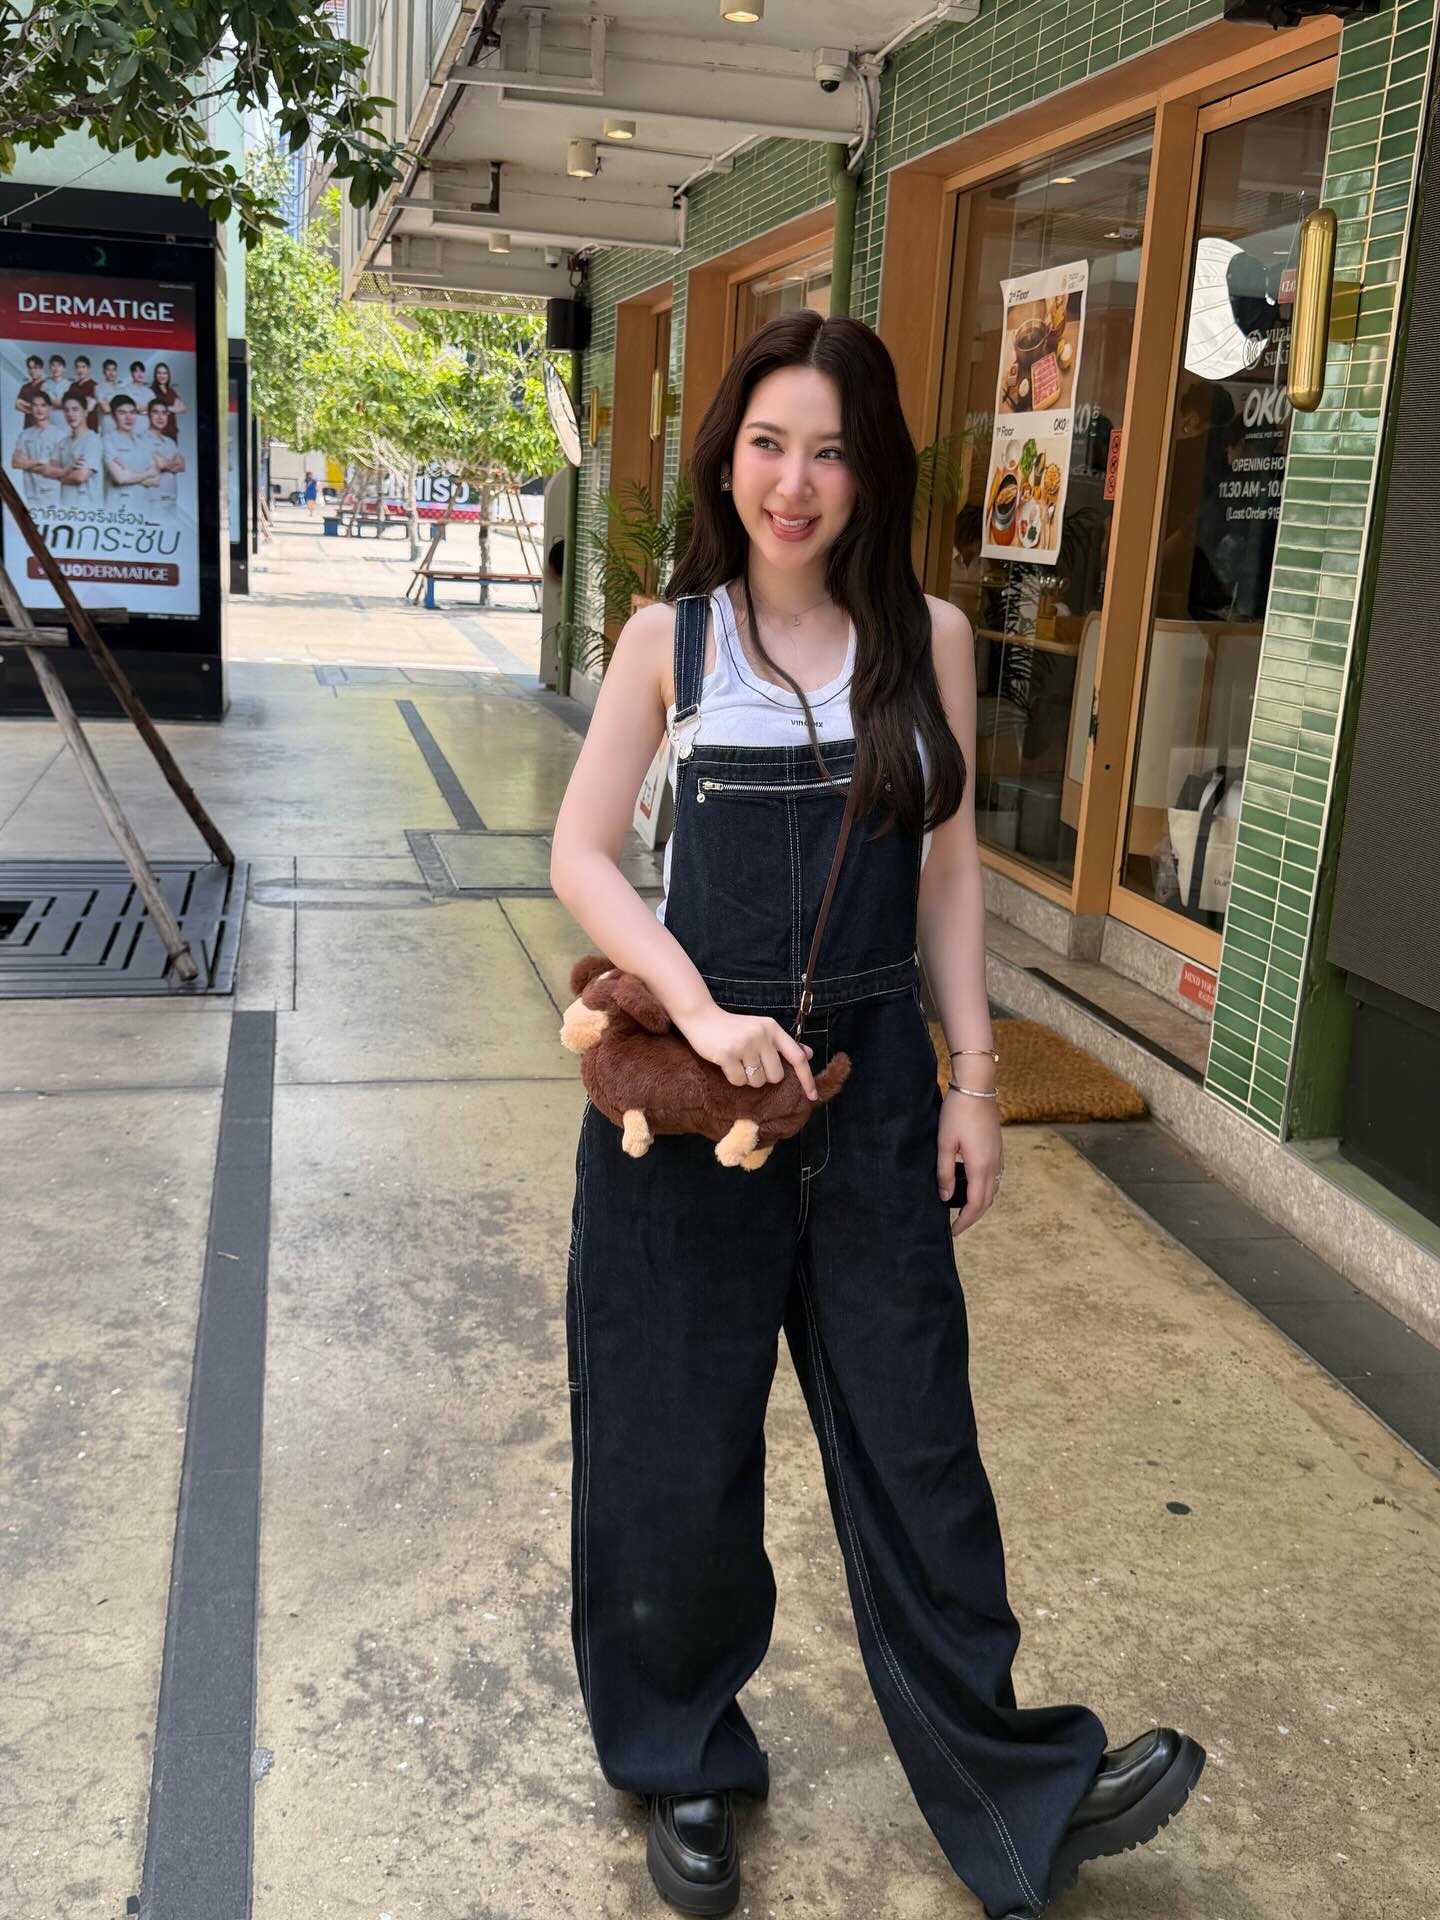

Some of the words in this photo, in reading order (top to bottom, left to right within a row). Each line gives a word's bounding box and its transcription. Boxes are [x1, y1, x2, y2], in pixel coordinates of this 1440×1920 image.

[18, 292, 175, 322] DERMATIGE
[1243, 385, 1292, 427] OKO
[1232, 457, 1270, 472] OPENING
[1271, 456, 1285, 470] HO
[1219, 481, 1242, 498] 11.30
[1241, 480, 1260, 498] AM
[31, 504, 144, 526] ราคือตัวจริงเรื่อง
[1245, 506, 1267, 519] Order
